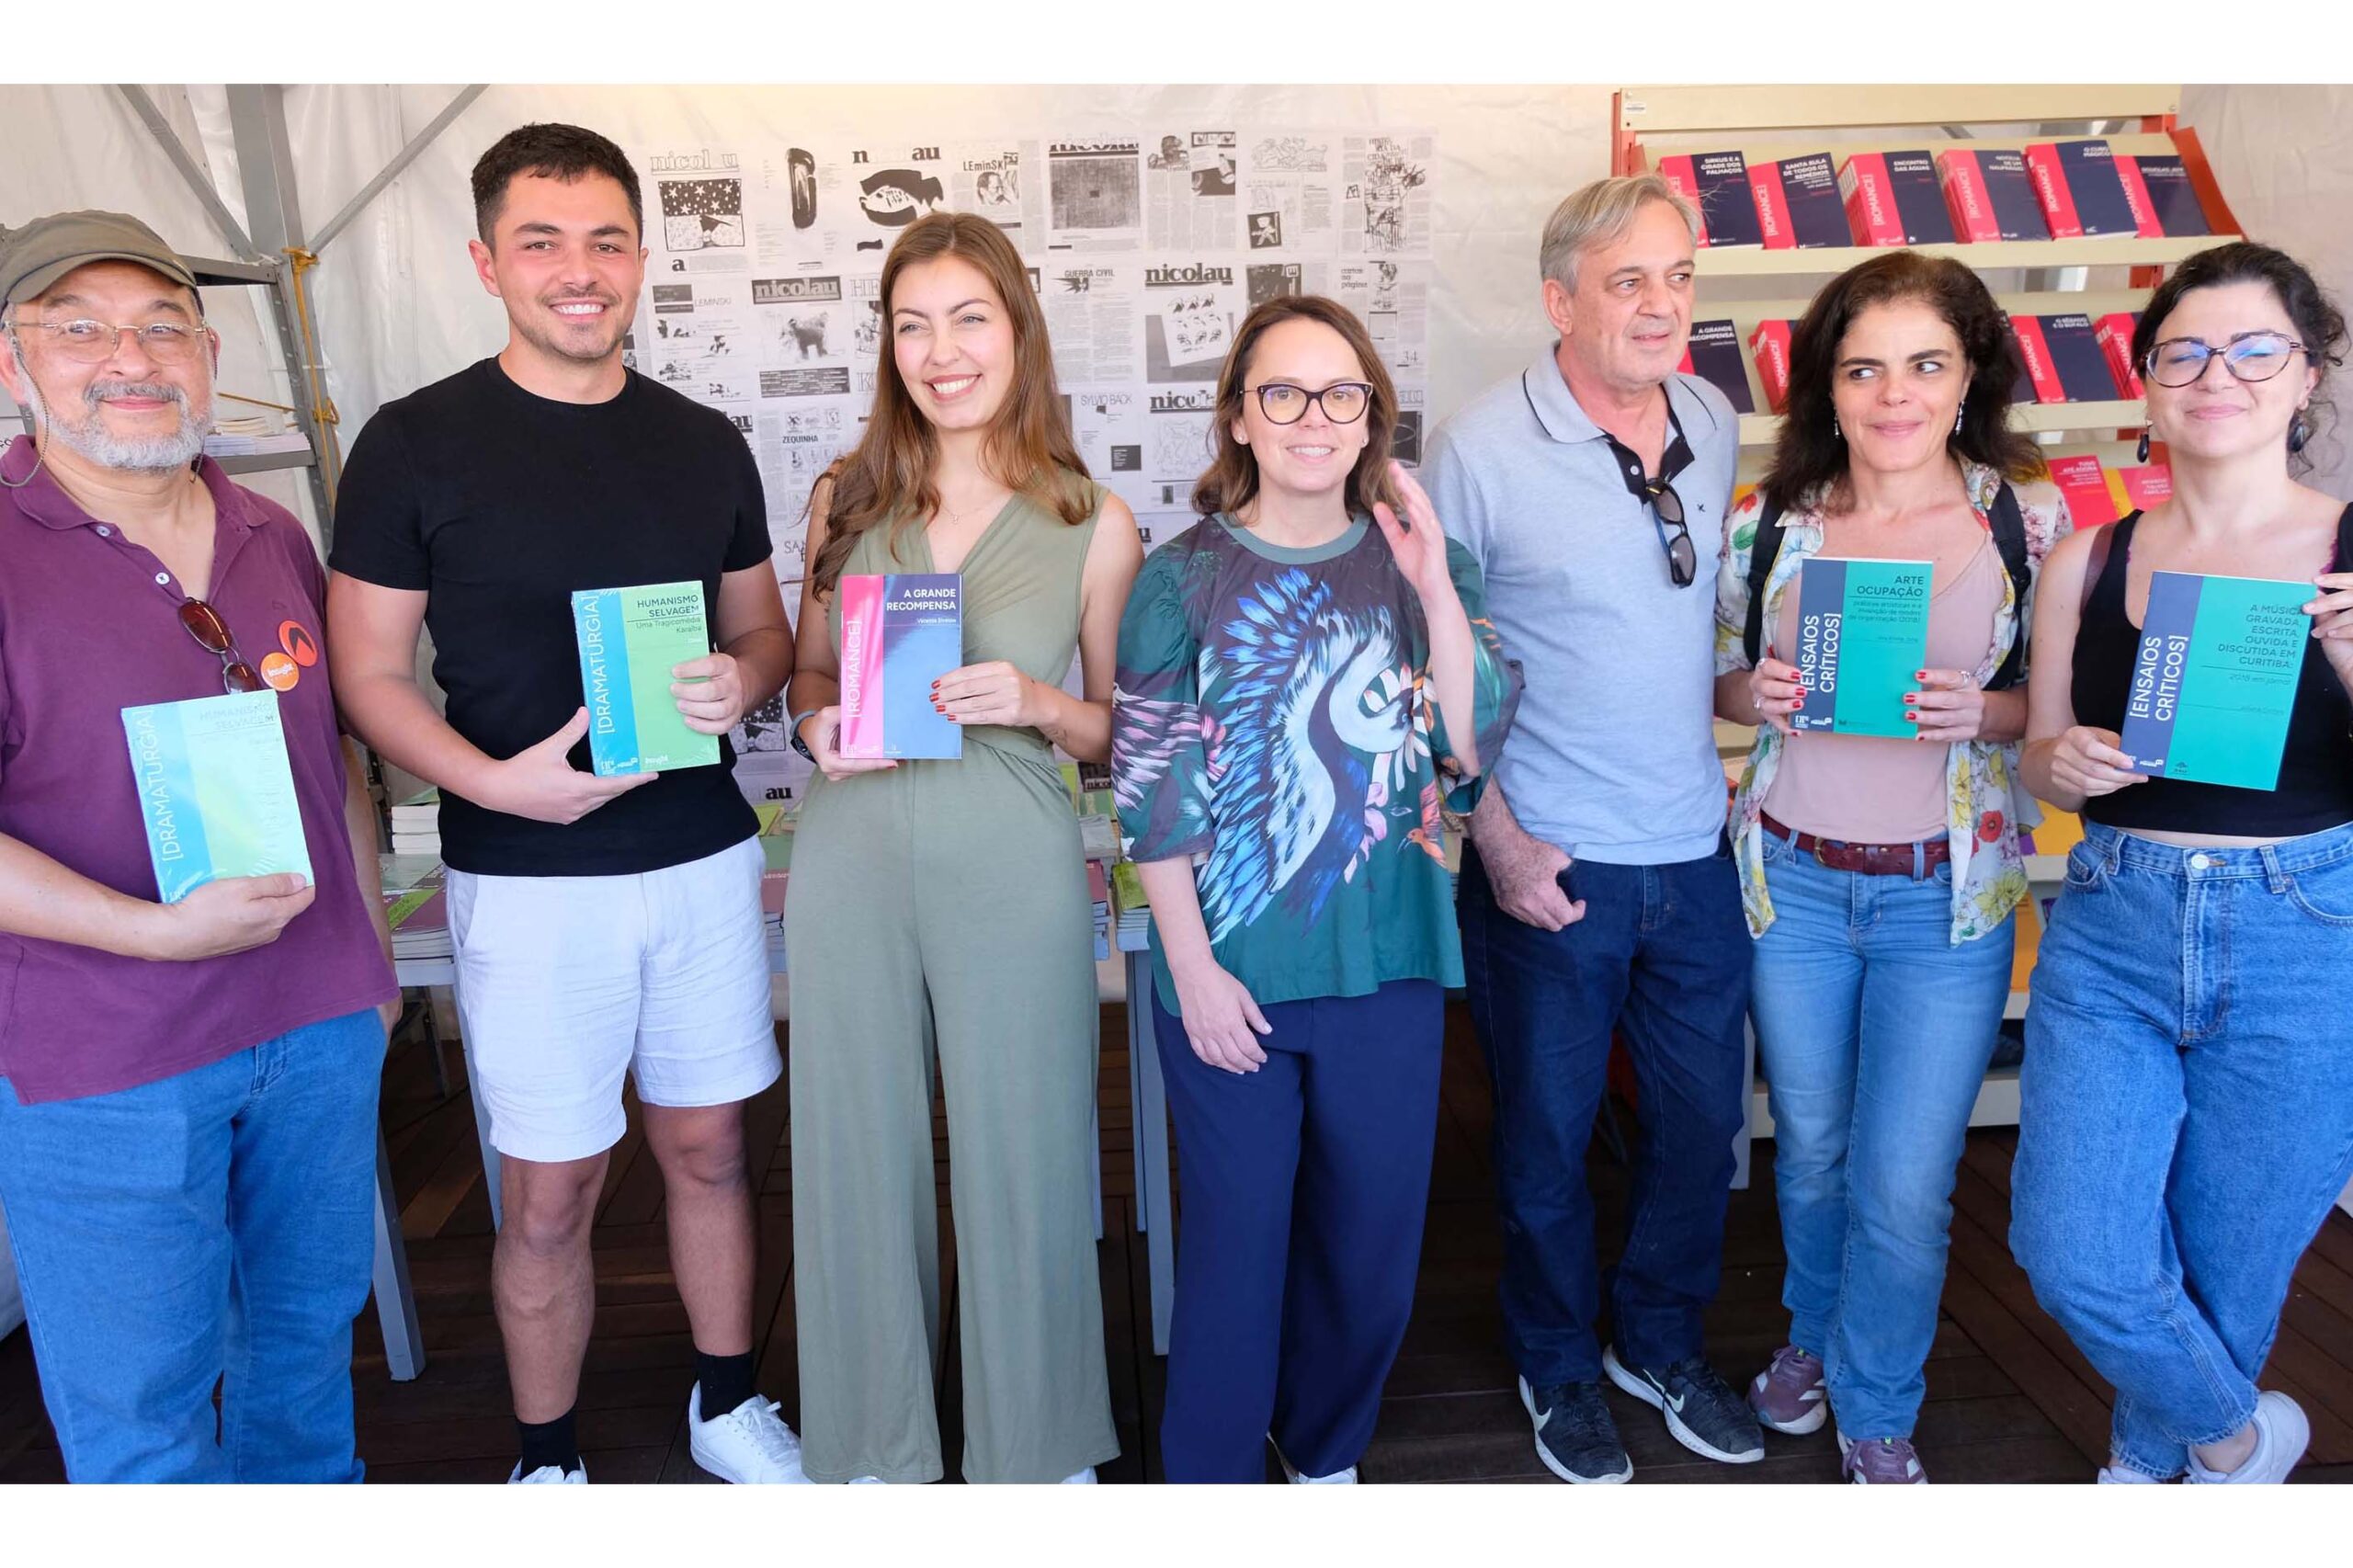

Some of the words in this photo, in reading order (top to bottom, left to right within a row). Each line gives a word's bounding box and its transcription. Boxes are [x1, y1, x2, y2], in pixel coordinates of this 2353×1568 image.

[1145, 263, 1233, 282] nicolau
[754, 278, 838, 299] nicolau
[1109, 393, 1132, 405] BACK
[782, 434, 818, 444] ZEQUINHA
[1894, 575, 1925, 585] ARTE
[904, 589, 912, 597] A
[914, 588, 956, 597] GRANDE
[1857, 585, 1924, 597] OCUPAÇÃO
[637, 594, 699, 608] HUMANISMO
[886, 601, 956, 611] RECOMPENSA
[649, 606, 699, 618] SELVAGEM
[2245, 635, 2288, 647] OUVIDA
[2291, 640, 2299, 648] E
[1819, 613, 1842, 693] CRÍTICOS]
[2218, 643, 2277, 656] DISCUTIDA
[2279, 649, 2296, 658] EM
[582, 595, 616, 735] [DRAMATURGIA]
[847, 620, 862, 718] [ROMANCE]
[2129, 636, 2162, 718] [ENSAIOS
[2154, 635, 2189, 722] CRÍTICOS]
[132, 710, 184, 862] [DRAMATURGIA]
